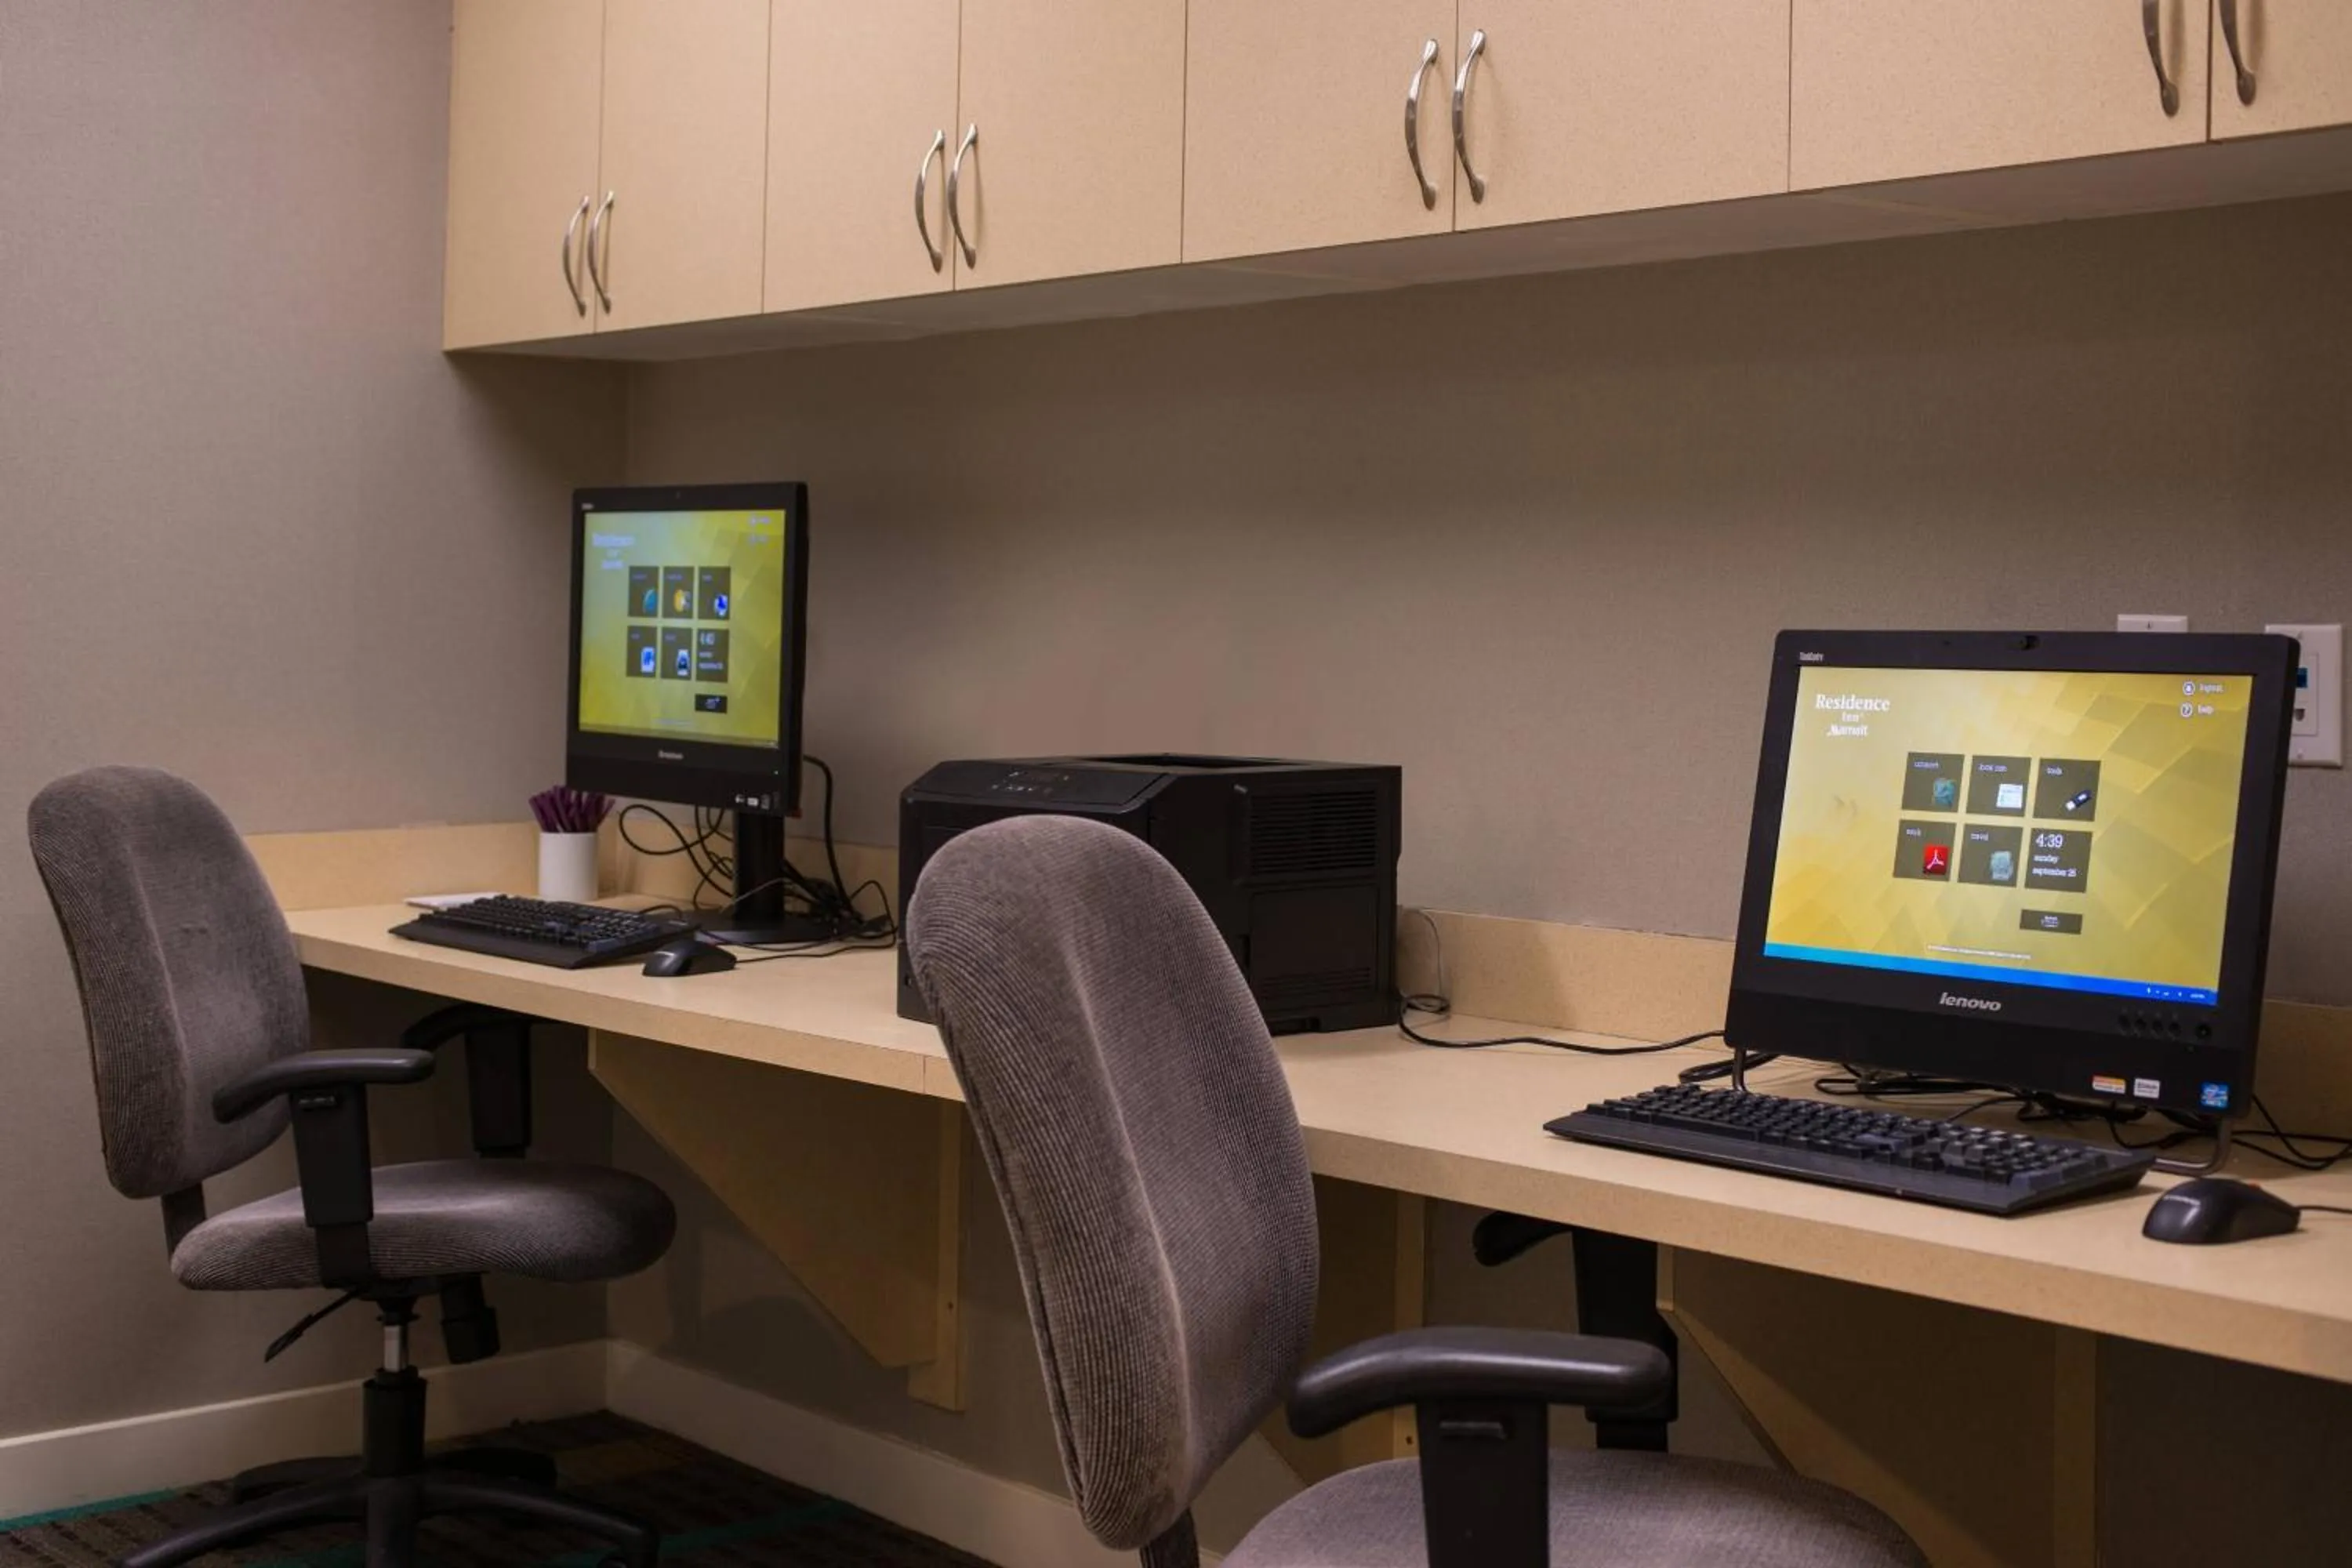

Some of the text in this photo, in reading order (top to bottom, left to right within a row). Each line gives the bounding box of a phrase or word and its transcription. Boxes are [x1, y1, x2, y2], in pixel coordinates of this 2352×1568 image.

[1815, 694, 1891, 712] Residence
[2035, 833, 2063, 848] 4:39
[1939, 992, 2002, 1012] lenovo
